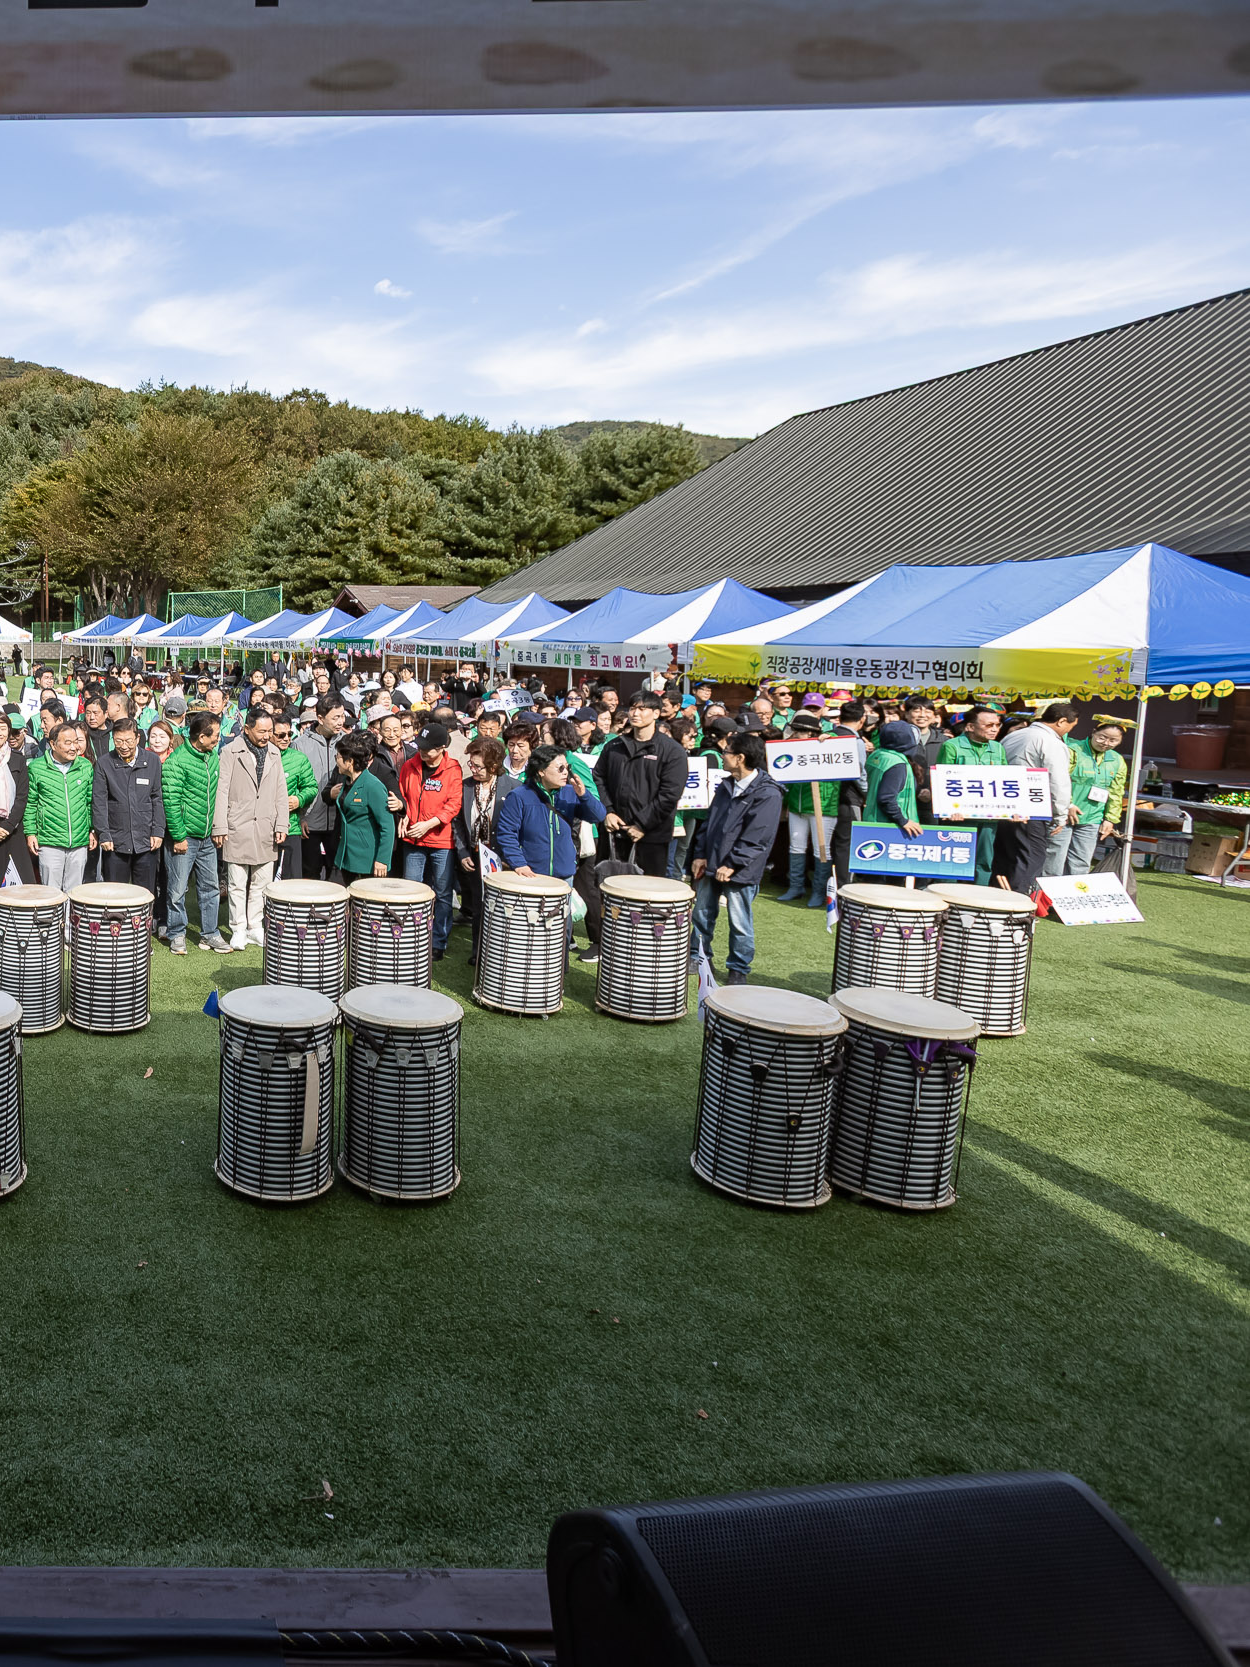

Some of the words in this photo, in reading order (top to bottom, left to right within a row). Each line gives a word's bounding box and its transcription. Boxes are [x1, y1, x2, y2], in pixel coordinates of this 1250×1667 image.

[517, 650, 547, 664] 중곡1동
[553, 653, 582, 667] 새마을
[589, 654, 638, 669] 최고예요!
[766, 655, 984, 682] 직장공장새마을운동광진구협의회
[796, 751, 854, 767] 중곡제2동
[945, 779, 1020, 798] 중곡1동
[887, 843, 971, 864] 중곡제1동
